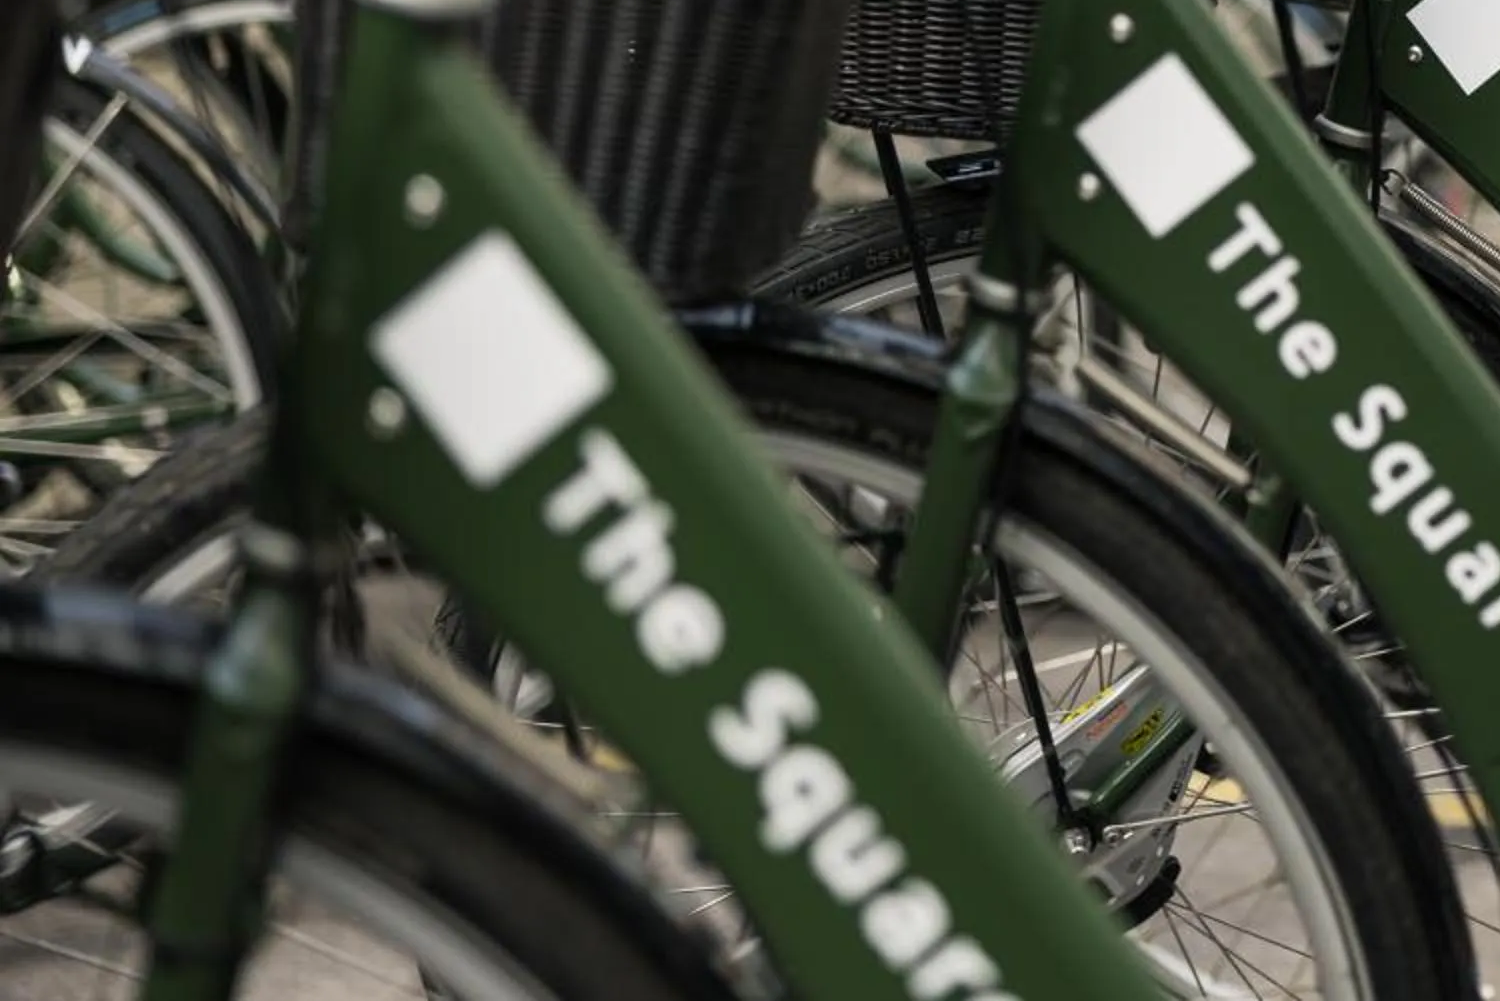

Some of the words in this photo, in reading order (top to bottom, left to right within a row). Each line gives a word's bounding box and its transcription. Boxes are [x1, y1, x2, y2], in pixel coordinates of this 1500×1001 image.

[1206, 200, 1339, 380] The
[544, 427, 725, 672] The
[708, 668, 1026, 1001] Squar
